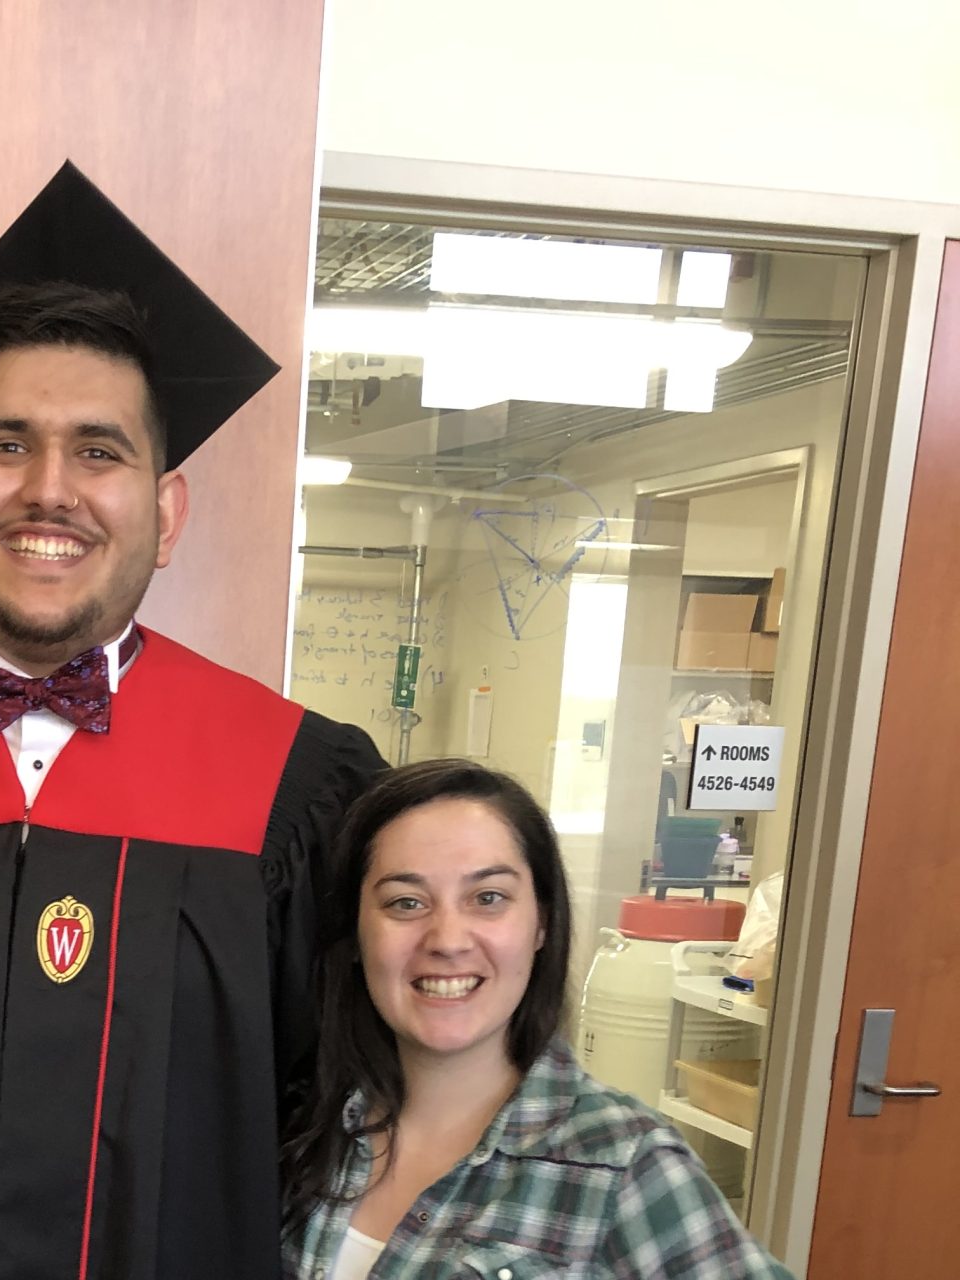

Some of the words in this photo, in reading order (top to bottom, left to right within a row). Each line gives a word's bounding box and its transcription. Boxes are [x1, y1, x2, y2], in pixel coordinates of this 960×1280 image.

[719, 745, 770, 761] ROOMS
[696, 775, 775, 791] 4526-4549
[49, 925, 82, 967] W
